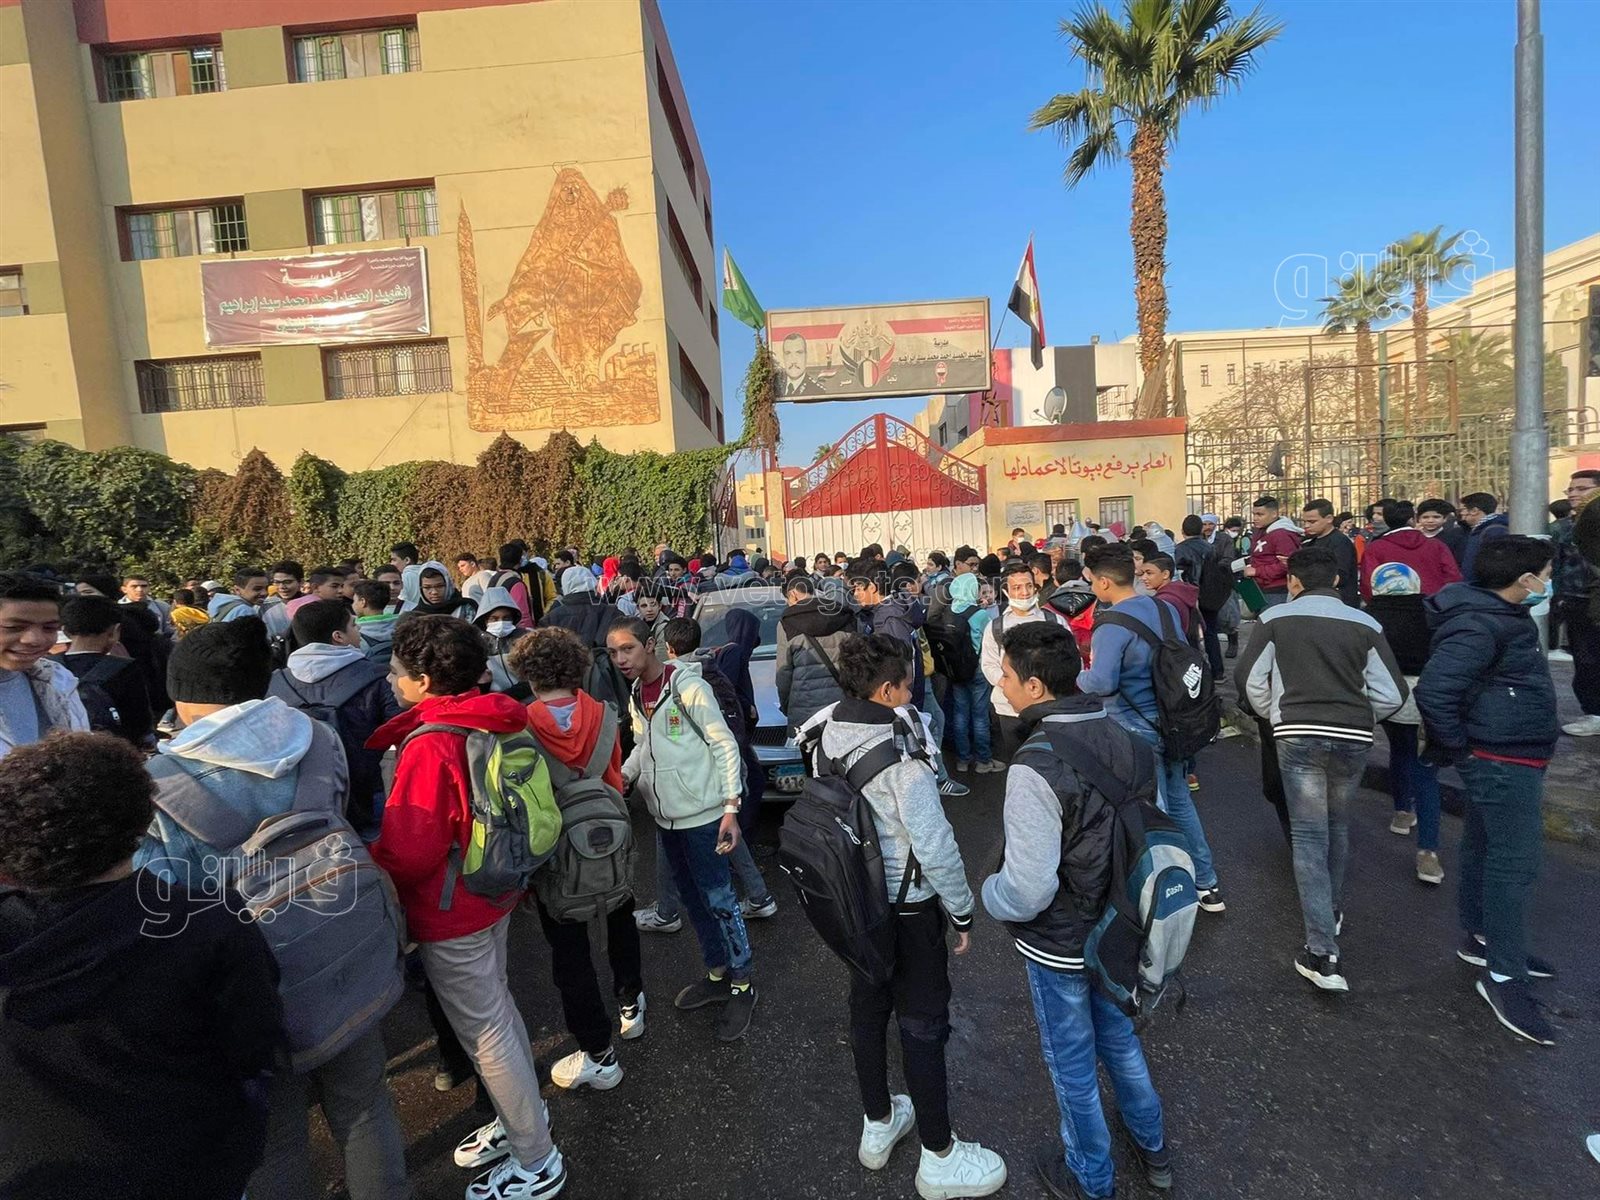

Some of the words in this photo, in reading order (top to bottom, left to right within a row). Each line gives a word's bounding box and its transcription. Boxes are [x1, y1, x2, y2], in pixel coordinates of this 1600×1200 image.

[260, 296, 280, 312] سيد
[375, 284, 412, 305] الشهيد
[219, 296, 258, 316] إبراهيم
[1103, 454, 1140, 480] يرفع
[1140, 451, 1173, 488] العلم
